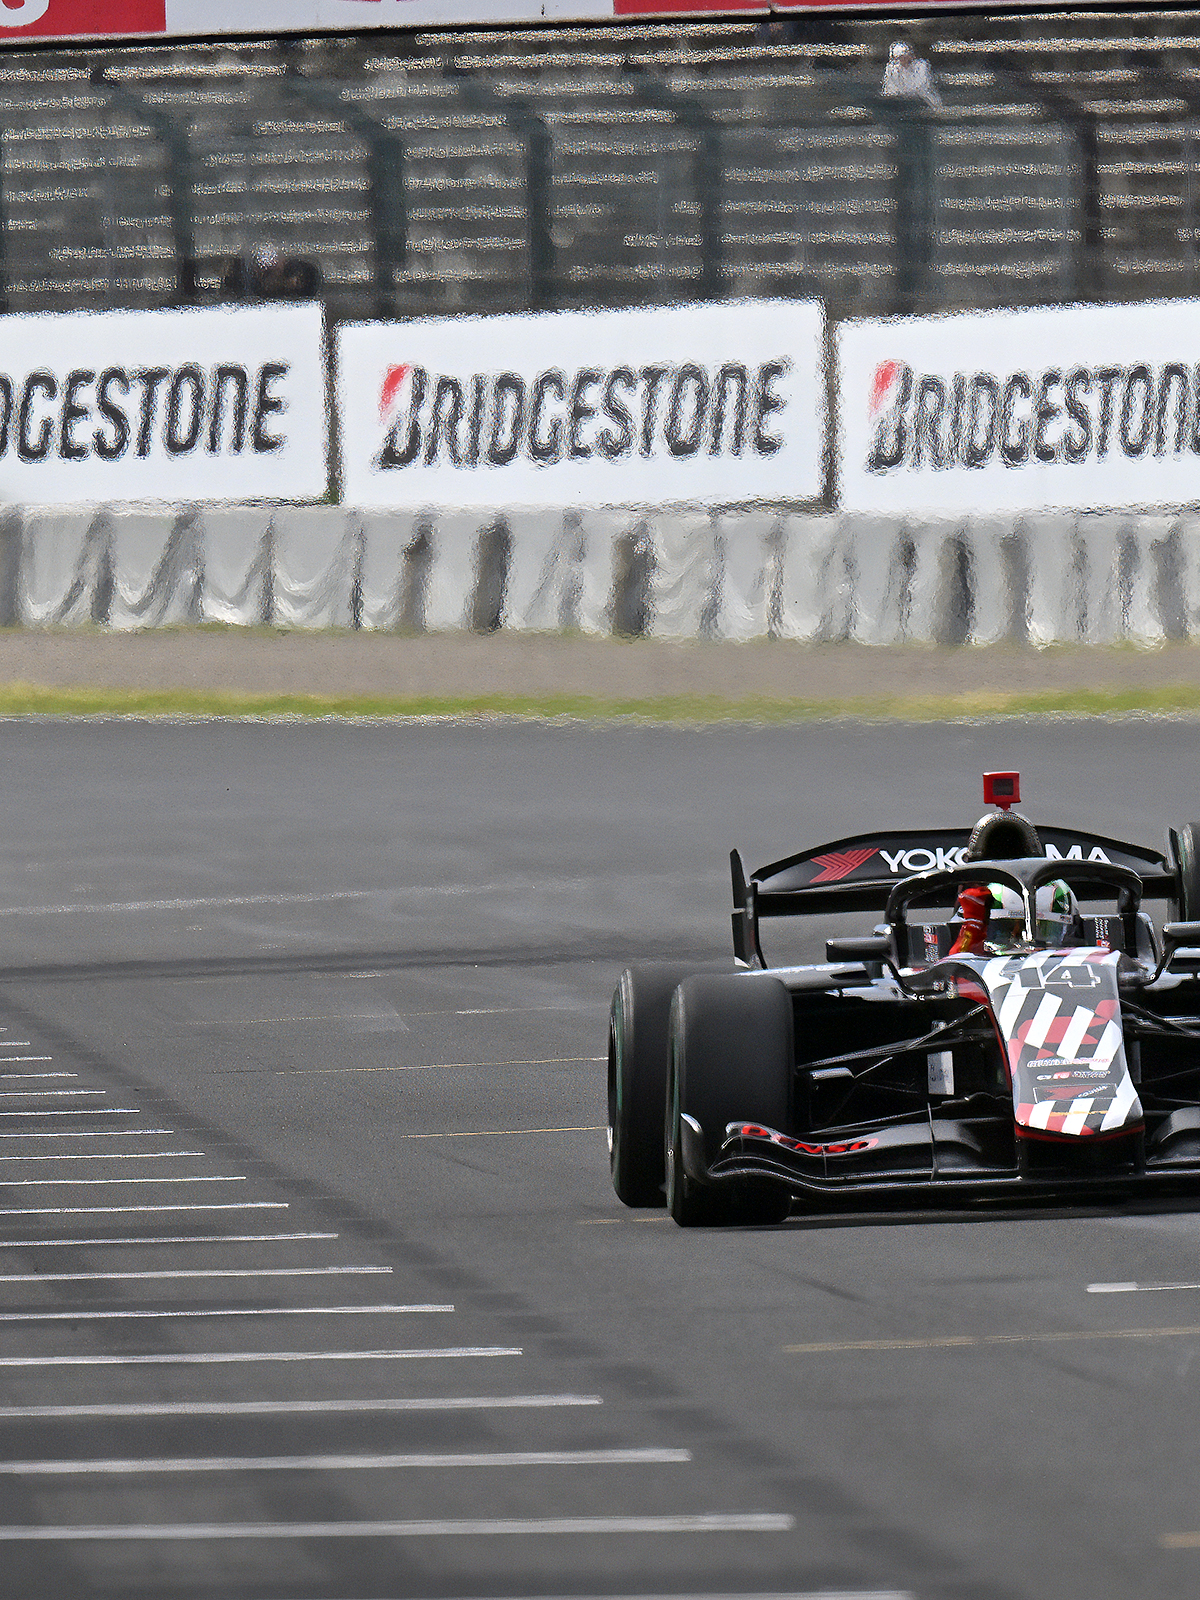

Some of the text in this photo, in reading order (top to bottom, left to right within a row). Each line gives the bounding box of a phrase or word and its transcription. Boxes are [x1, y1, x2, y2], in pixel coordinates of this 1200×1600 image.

[374, 361, 788, 470] BRIDGESTONE
[879, 843, 1112, 873] YOKOMA
[741, 1124, 879, 1155] DENSO
